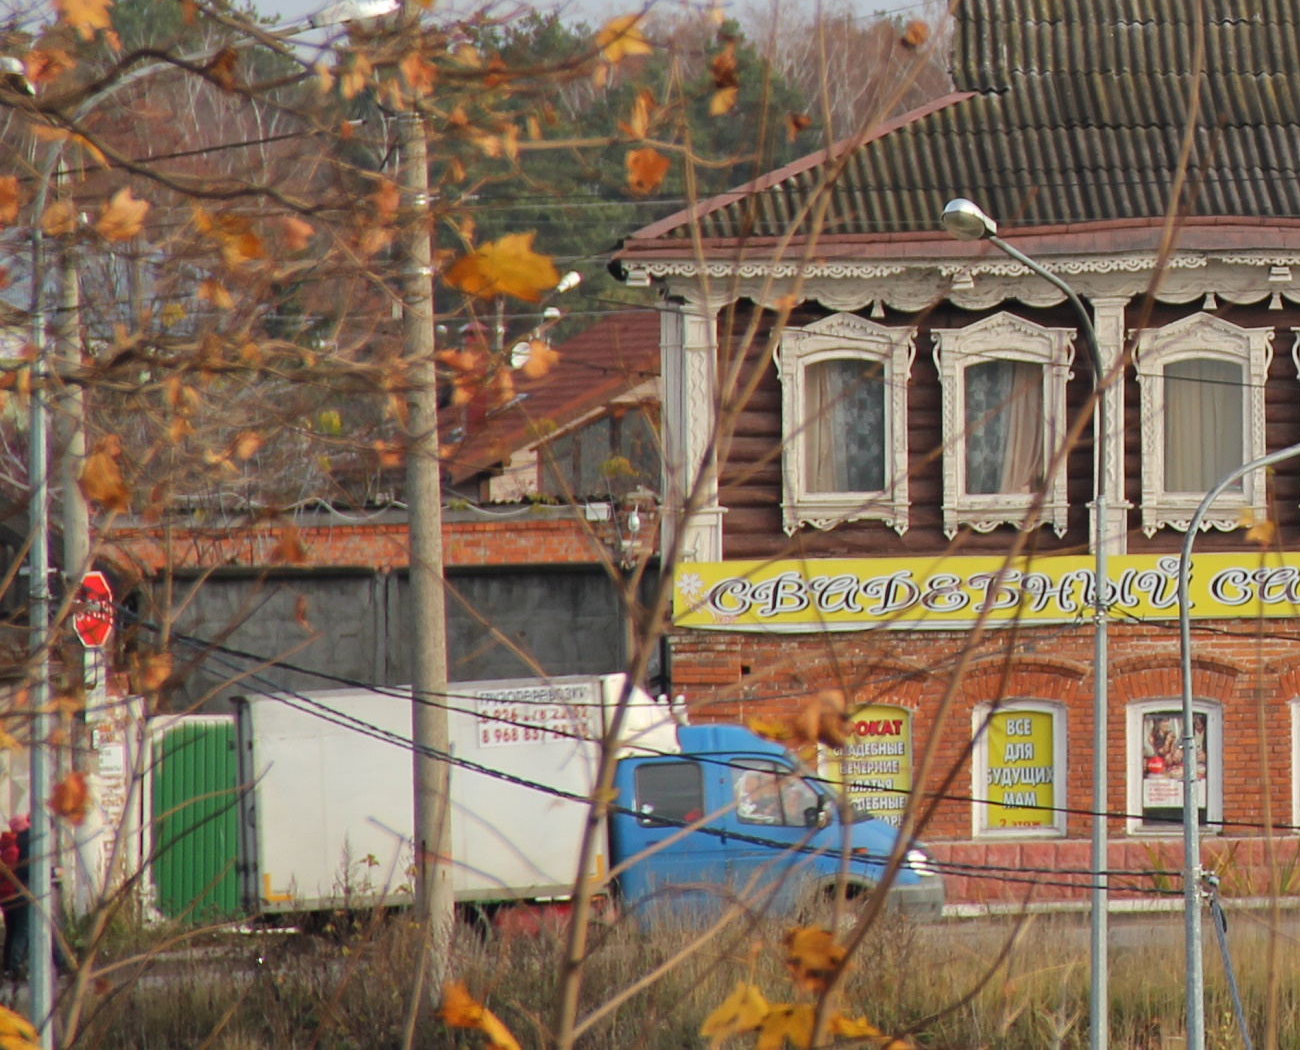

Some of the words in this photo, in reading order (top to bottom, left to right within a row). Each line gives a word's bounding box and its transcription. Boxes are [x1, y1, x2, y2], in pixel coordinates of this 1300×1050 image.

[706, 557, 1195, 616] СВАДЕБНЫЙ
[845, 720, 902, 737] РОКАТ
[1006, 718, 1032, 736] ВСЕ
[1004, 742, 1034, 763] ДЛЯ
[1003, 791, 1036, 809] МАМ
